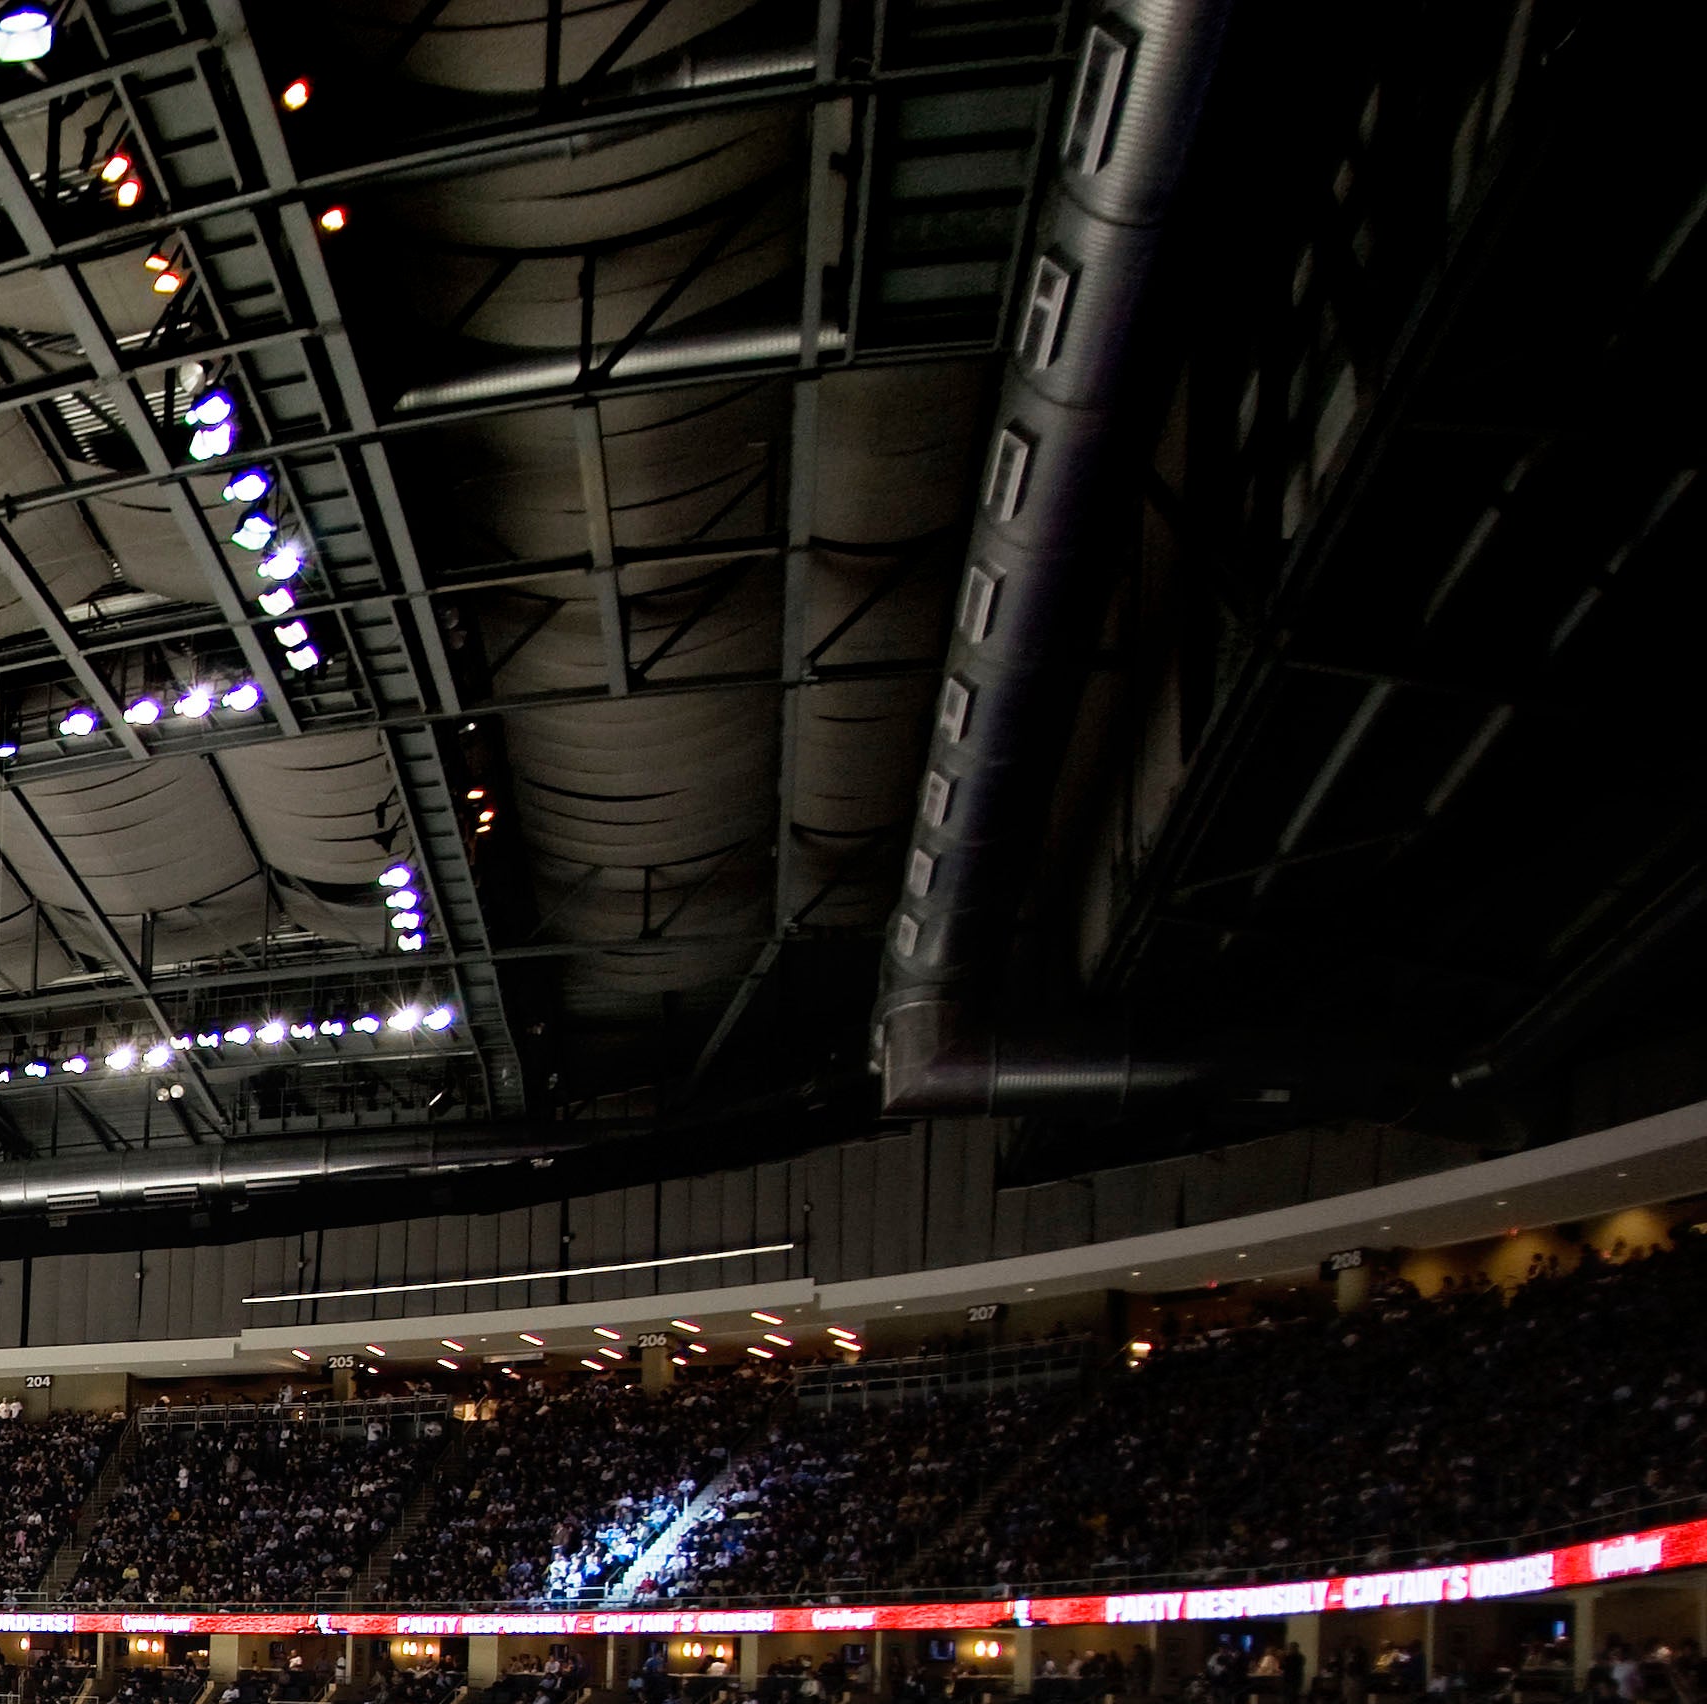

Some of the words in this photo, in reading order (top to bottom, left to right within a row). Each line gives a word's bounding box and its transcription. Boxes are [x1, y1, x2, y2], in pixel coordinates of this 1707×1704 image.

[328, 1357, 354, 1368] 205
[27, 1376, 51, 1387] 204
[1106, 1594, 1182, 1623] PARTY
[1188, 1582, 1330, 1620] RESPONSIBLY
[1343, 1567, 1469, 1610] CAPTAIN'S
[397, 1616, 457, 1634] PARTY
[462, 1615, 577, 1633] RESPONSIBLY
[593, 1614, 694, 1633] CAPTAIN'S
[699, 1612, 773, 1631] ORDERS!
